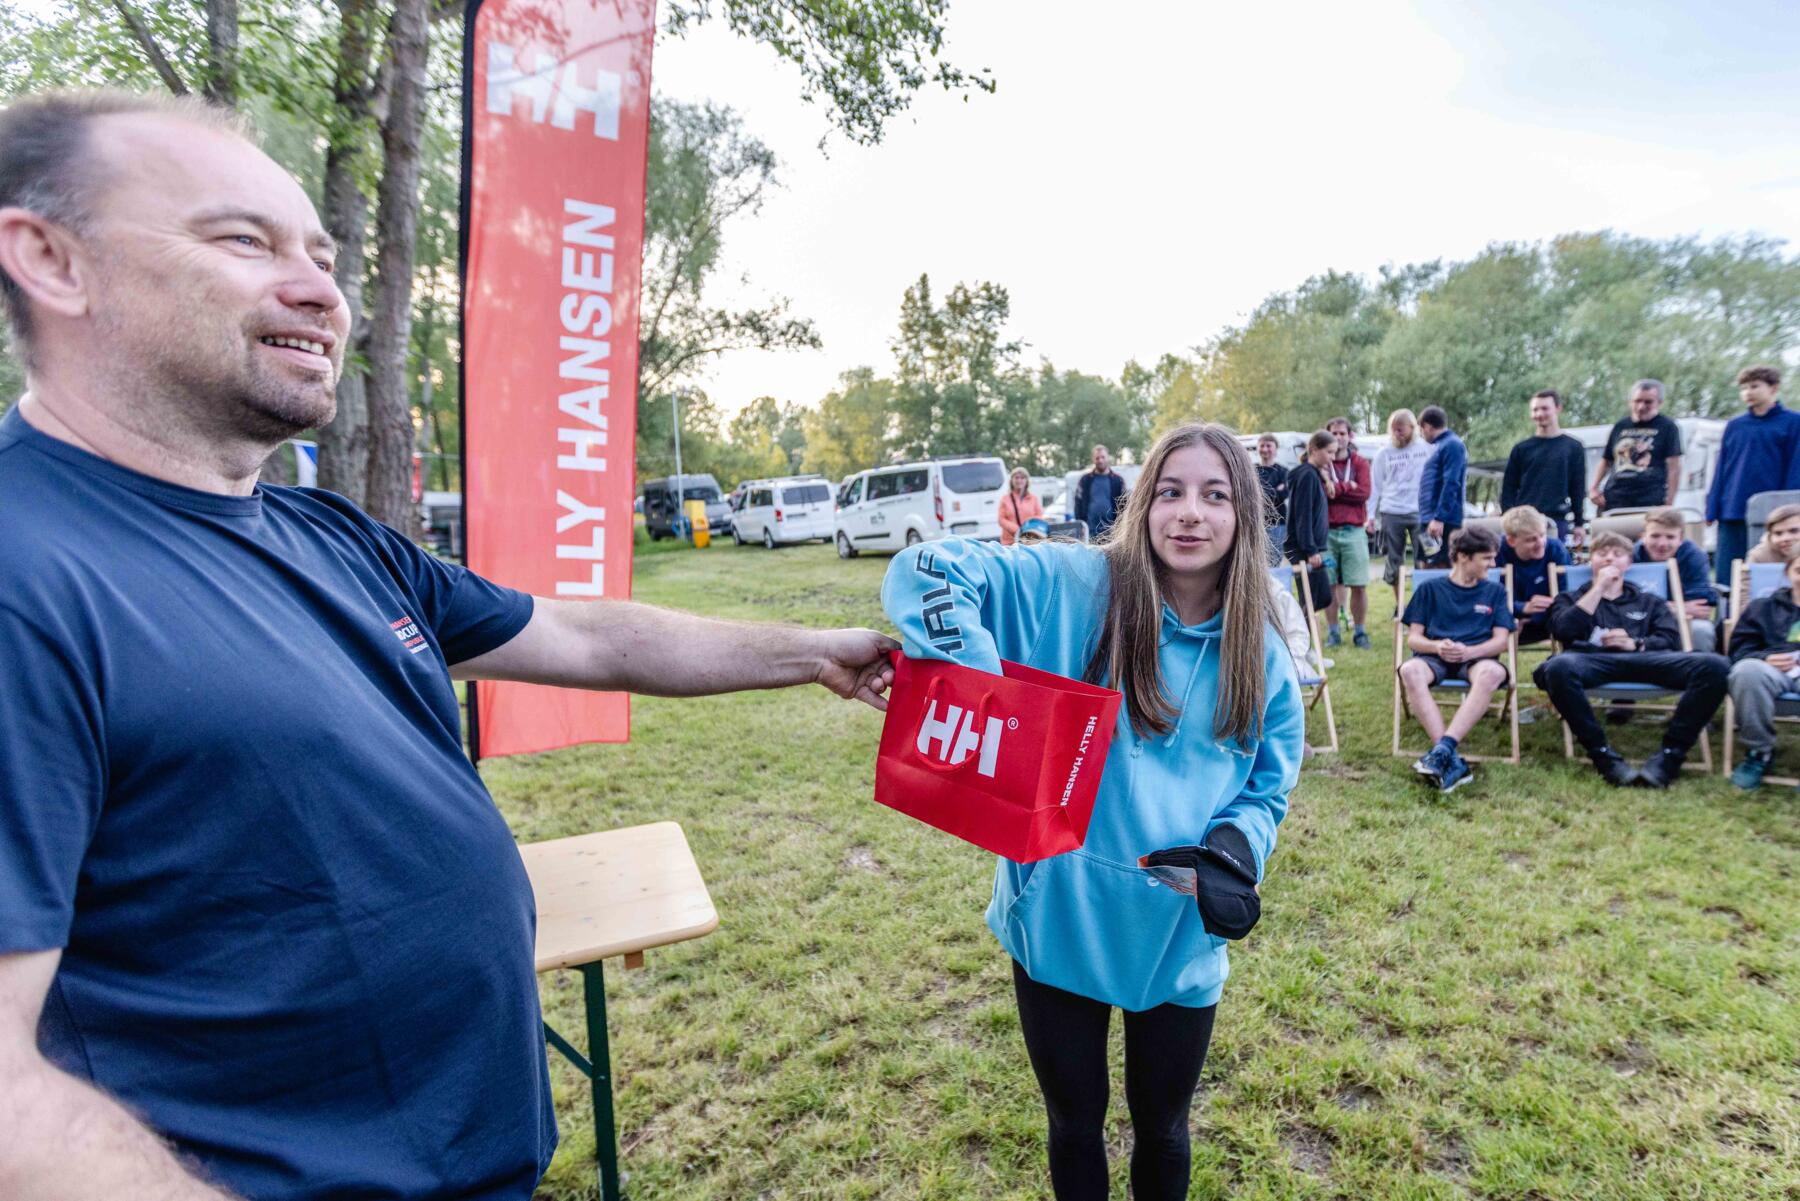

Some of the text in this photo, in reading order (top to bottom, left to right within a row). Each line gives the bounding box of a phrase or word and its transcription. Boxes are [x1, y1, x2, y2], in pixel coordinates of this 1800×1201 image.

[487, 41, 620, 141] HH
[556, 198, 617, 596] LLY HANSEN
[1060, 715, 1098, 807] HELLY HANSEN
